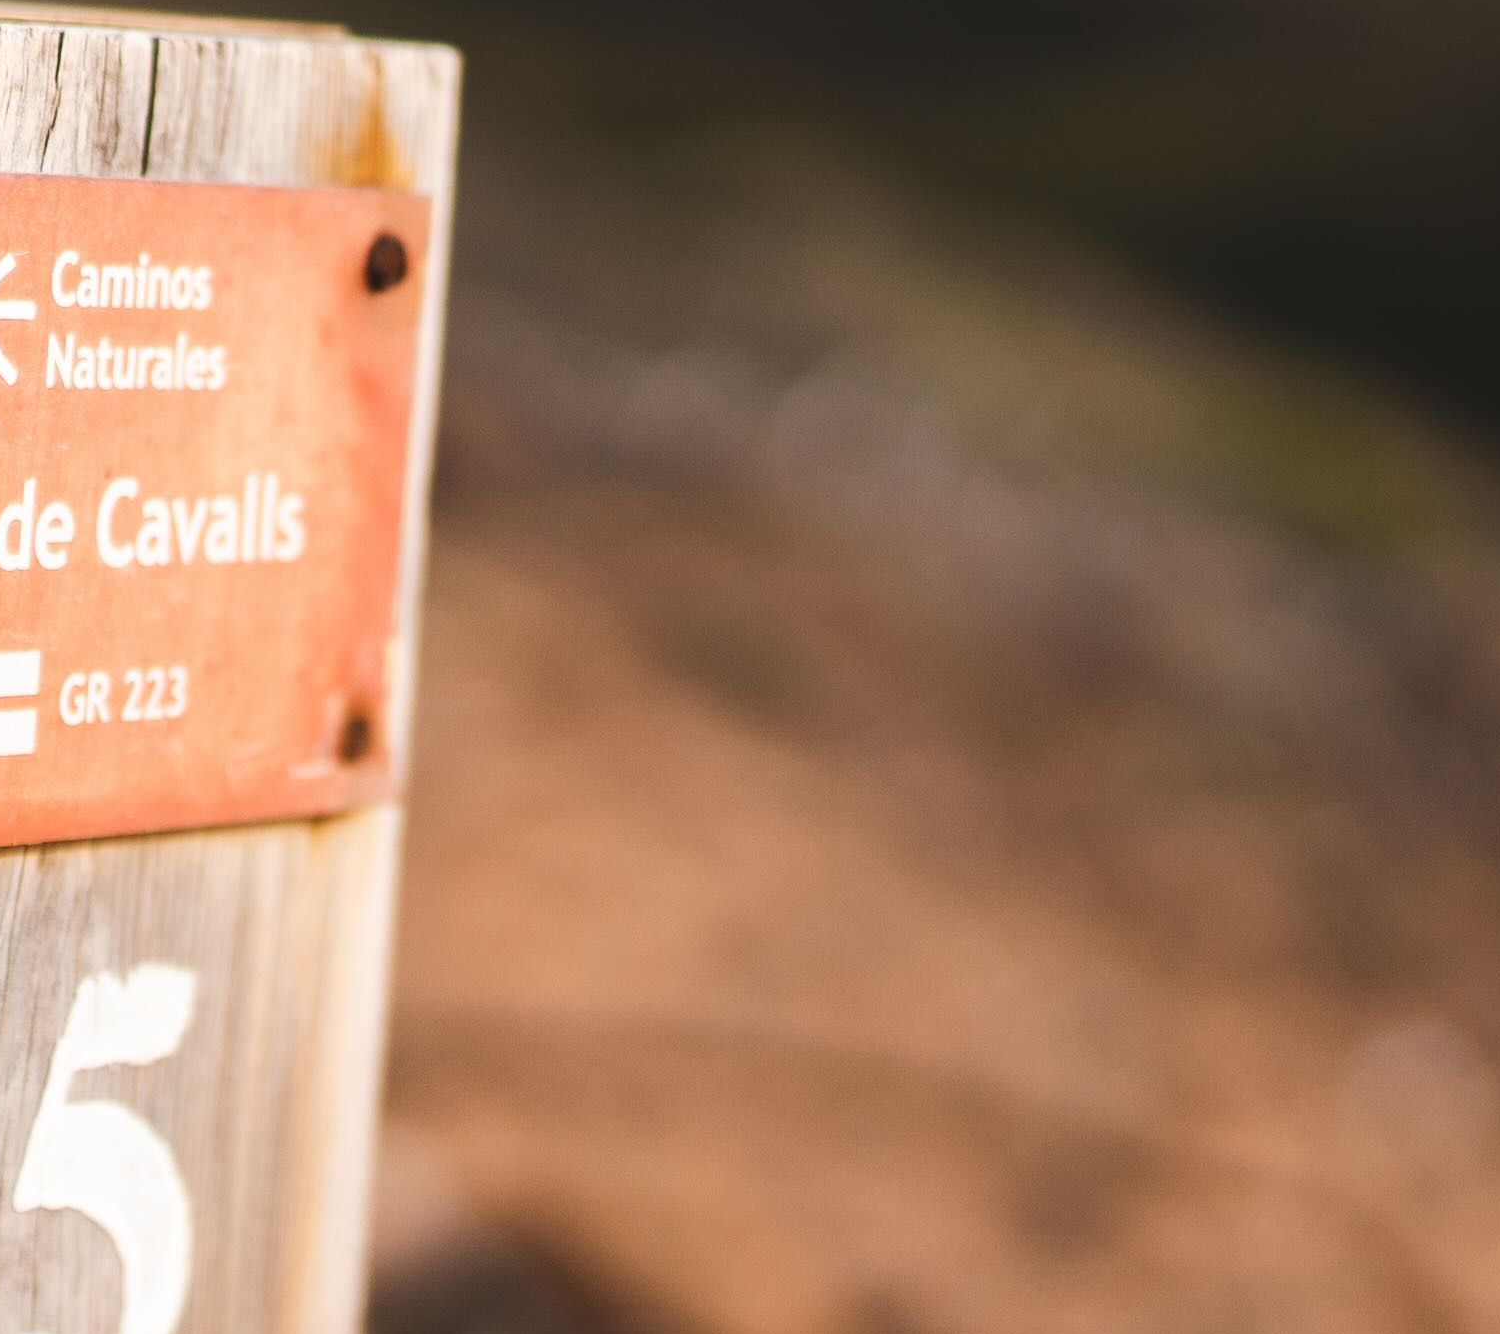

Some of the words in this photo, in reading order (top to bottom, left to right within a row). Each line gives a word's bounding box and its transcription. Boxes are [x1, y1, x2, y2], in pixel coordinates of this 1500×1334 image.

[51, 250, 212, 310] Caminos
[45, 332, 227, 390] Naturales
[96, 471, 304, 569] Cavalls
[59, 671, 111, 726] GR
[122, 666, 188, 721] 223
